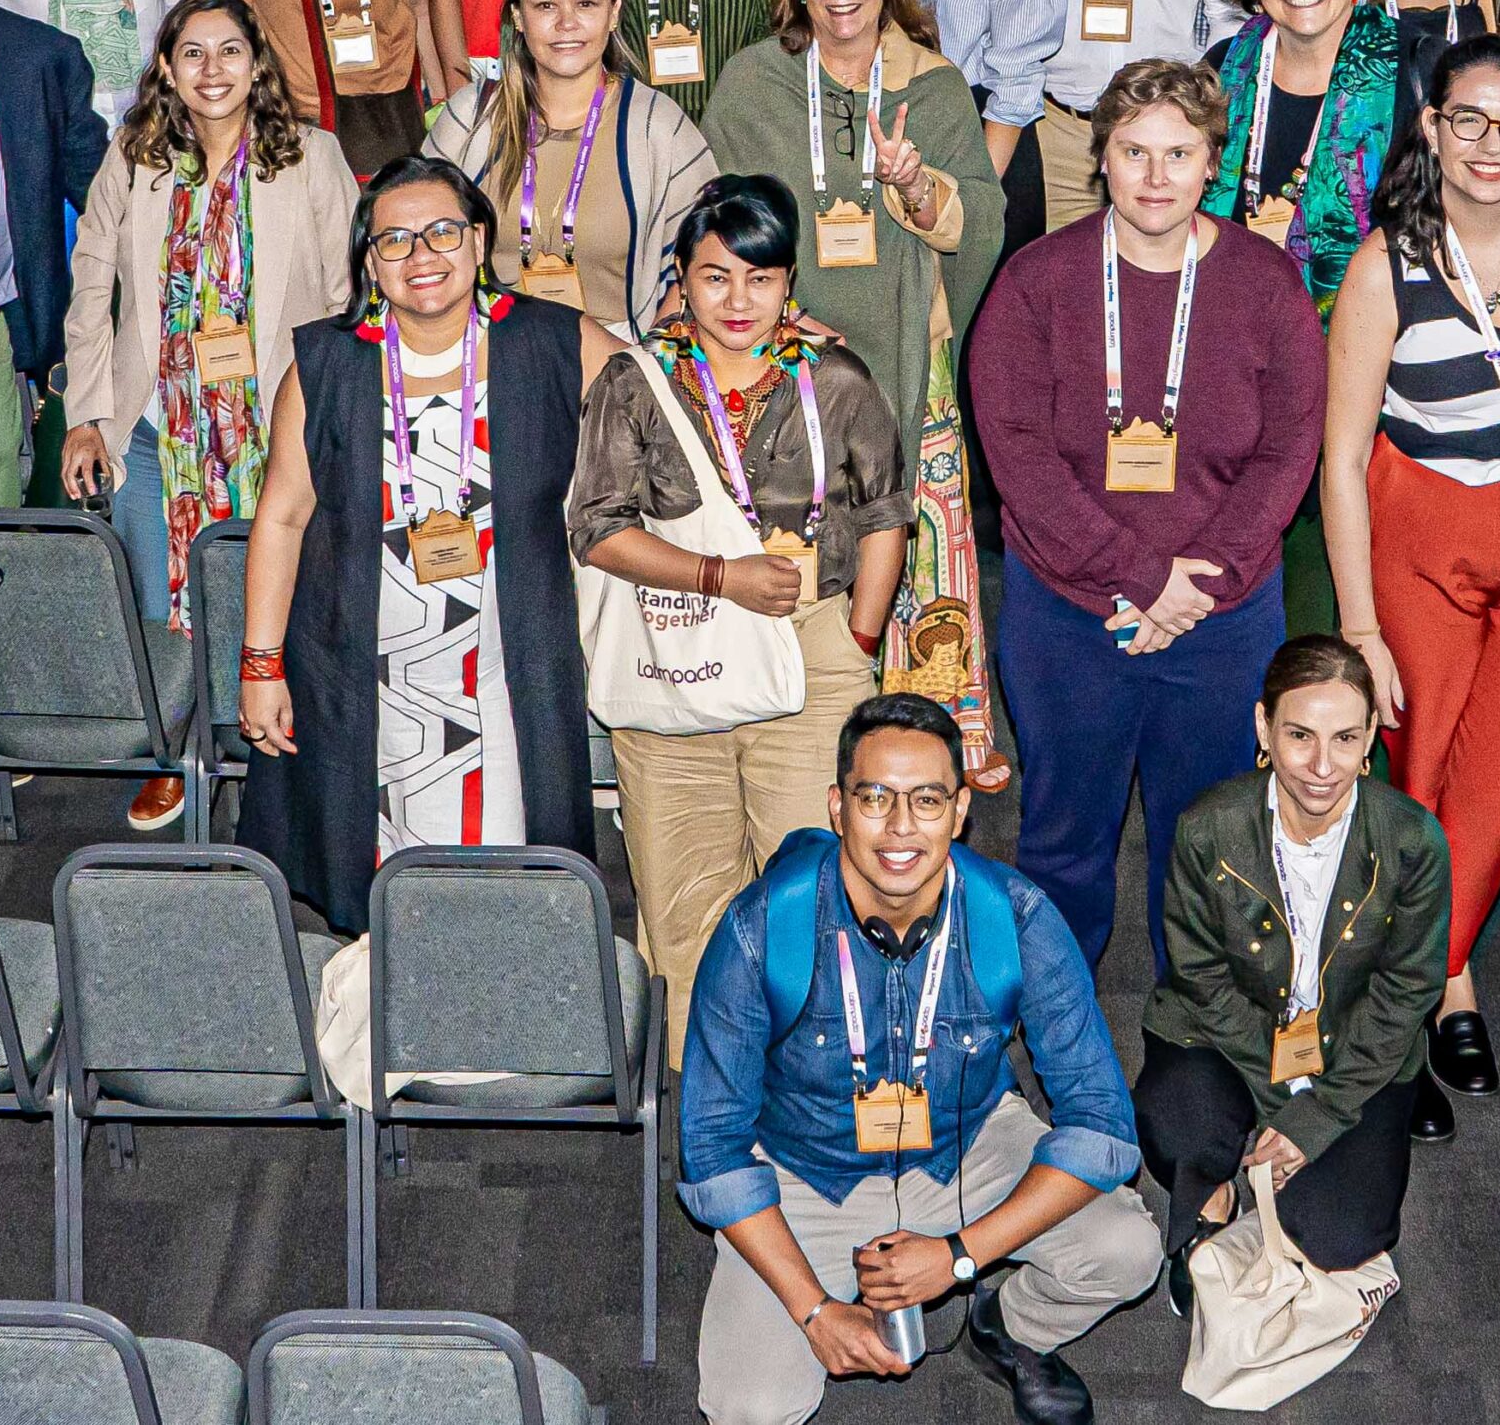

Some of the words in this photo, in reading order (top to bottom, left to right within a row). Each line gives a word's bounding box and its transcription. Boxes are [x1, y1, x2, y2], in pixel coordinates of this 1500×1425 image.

[1260, 50, 1272, 87] Latimpacto
[585, 106, 600, 139] Latimpacto
[811, 124, 821, 157] Latimpacto
[1107, 281, 1115, 301] Impact
[1182, 257, 1196, 295] Latimpacto
[1107, 310, 1116, 347] Latimpacto
[1178, 302, 1189, 323] Impact
[389, 345, 401, 383] Latimpacto
[700, 368, 718, 407] Latimpacto
[636, 585, 711, 613] tanding
[640, 604, 718, 631] ogether
[1272, 841, 1288, 882] Latimpacto
[1283, 891, 1293, 913] Impact
[925, 970, 937, 996] Impact
[845, 991, 861, 1034] Latimpacto
